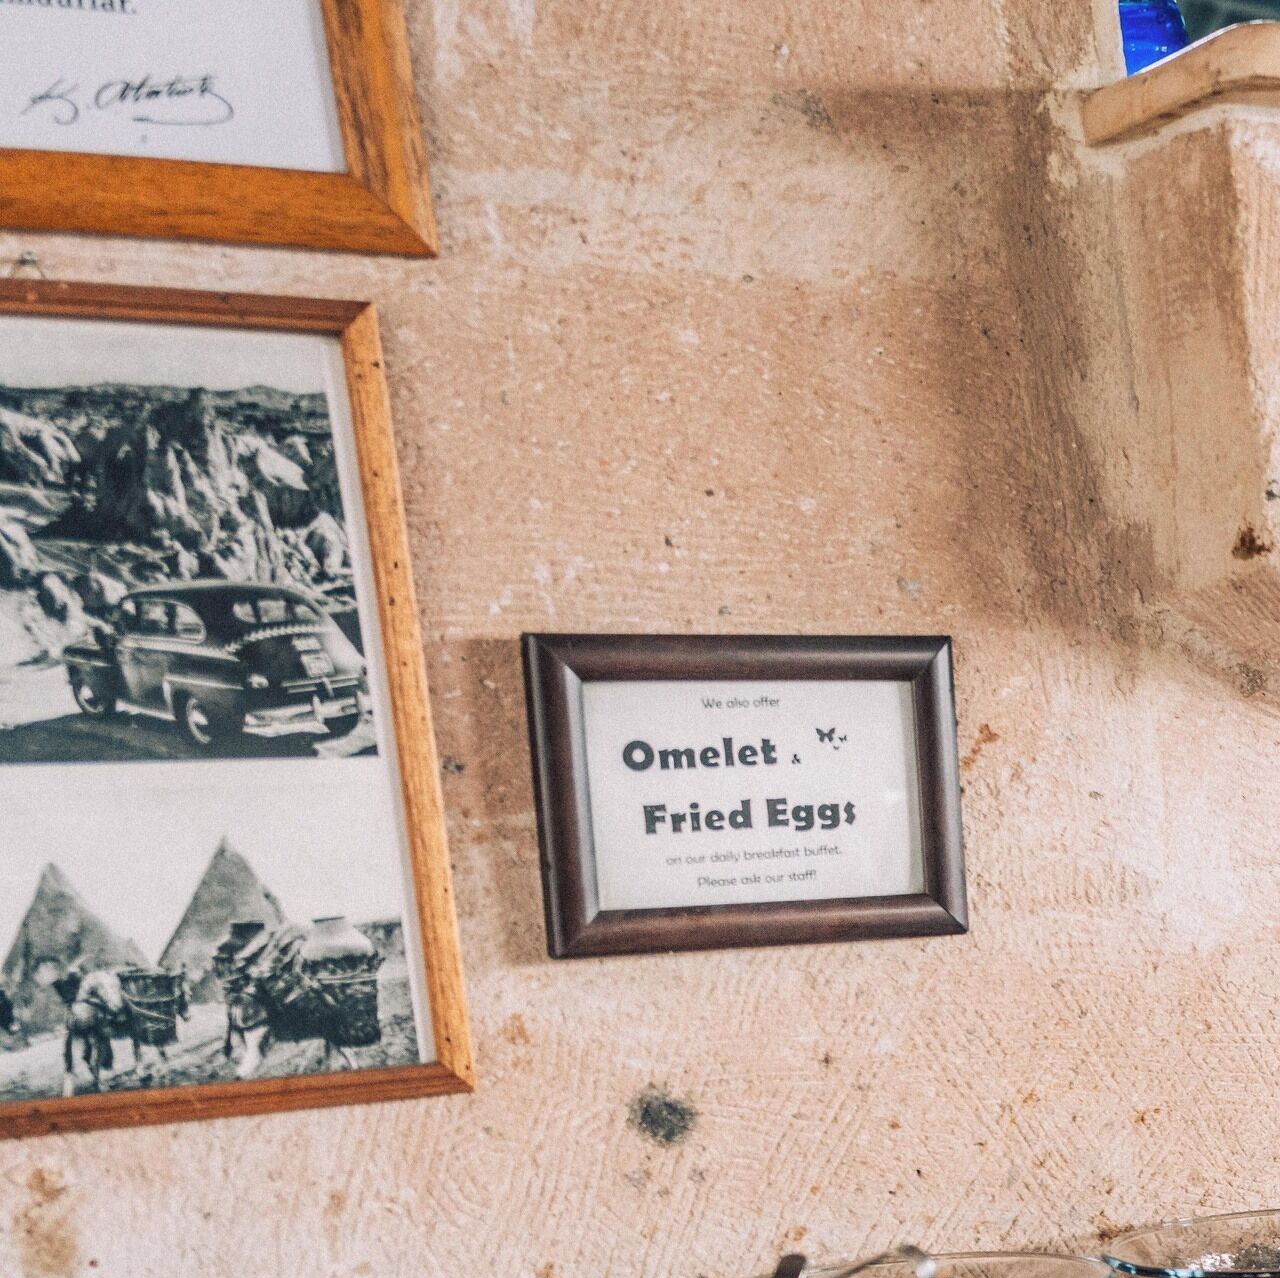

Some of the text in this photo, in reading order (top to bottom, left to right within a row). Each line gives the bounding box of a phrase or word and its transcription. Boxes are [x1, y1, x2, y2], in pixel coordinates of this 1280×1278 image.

[701, 694, 780, 710] We also offer
[622, 736, 802, 773] Omelet &
[642, 797, 856, 836] Fried Eggs
[665, 855, 683, 867] on
[685, 854, 706, 866] our
[710, 850, 740, 865] daily
[743, 848, 801, 863] breakfast
[696, 875, 737, 890] Please
[740, 873, 762, 887] ask
[764, 872, 785, 884] our
